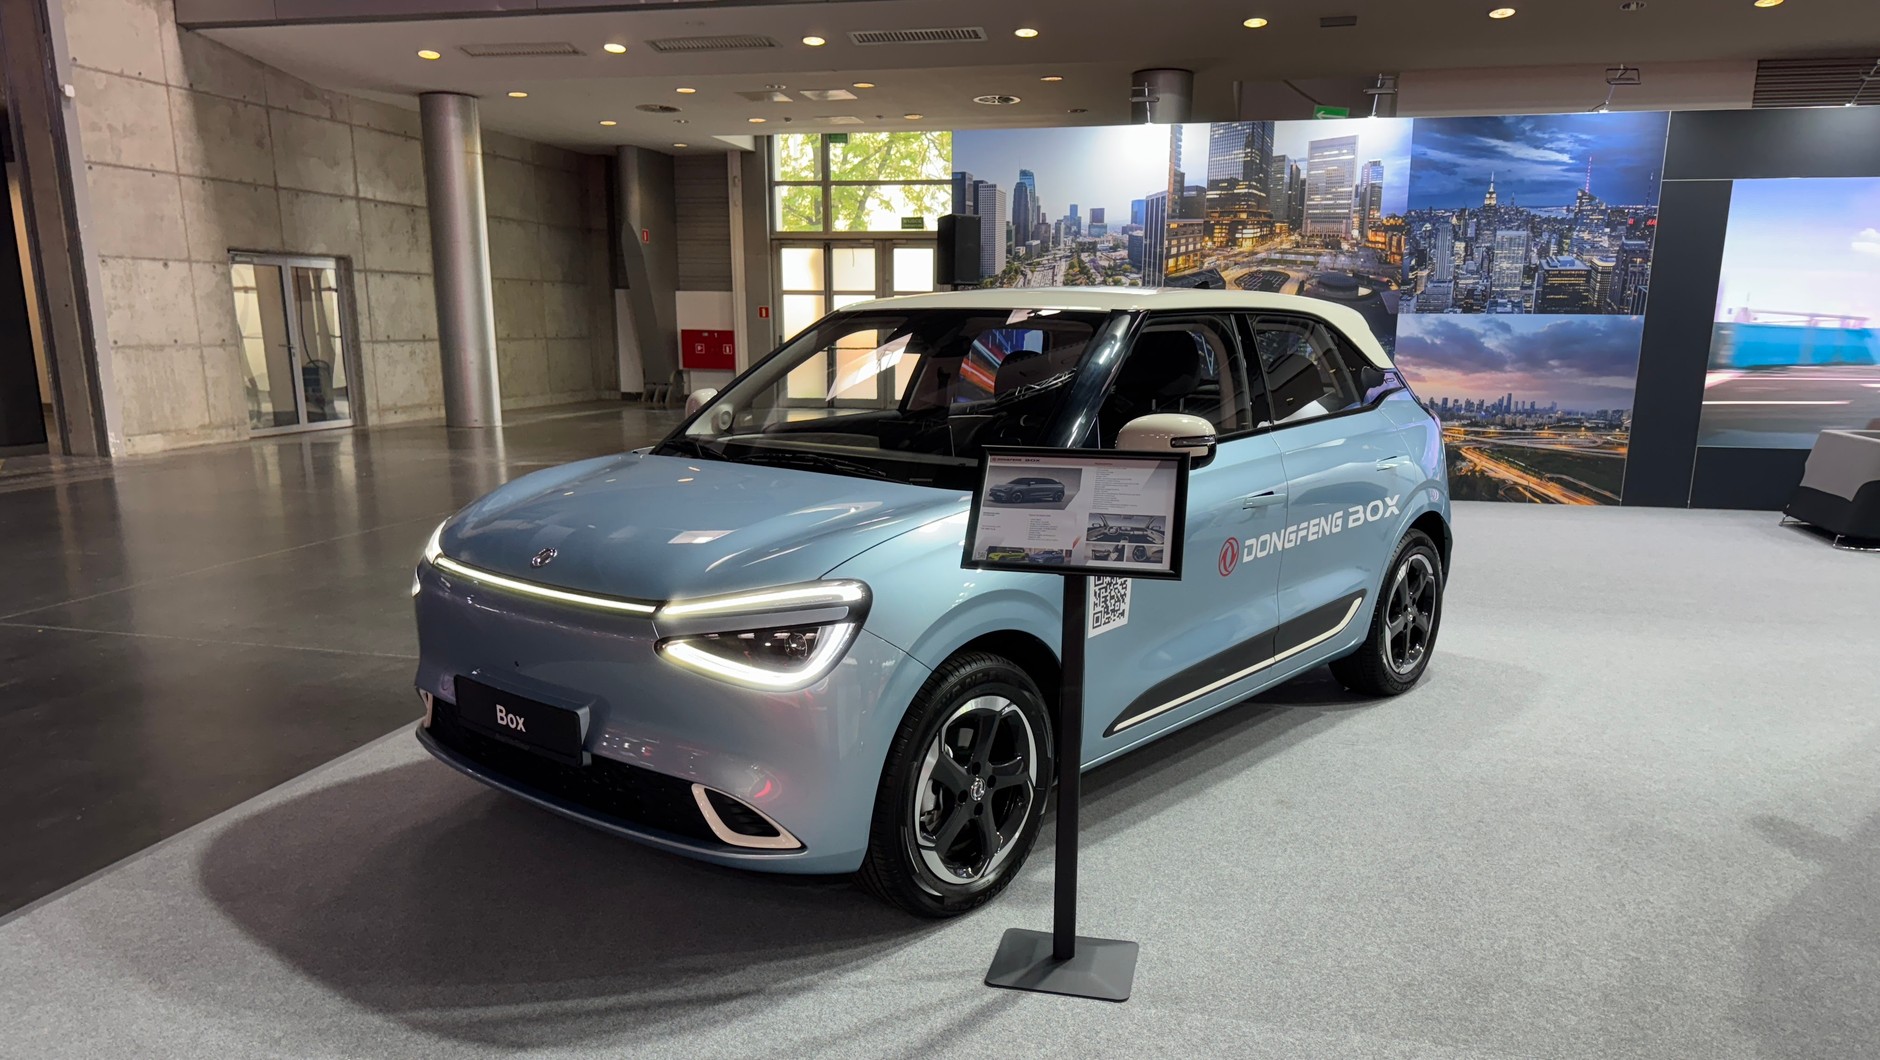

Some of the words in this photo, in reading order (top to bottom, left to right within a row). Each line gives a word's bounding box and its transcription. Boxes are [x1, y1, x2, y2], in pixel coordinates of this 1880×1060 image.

[1243, 511, 1343, 563] DONGFENG
[1348, 494, 1400, 528] BOX
[496, 704, 526, 732] Box
